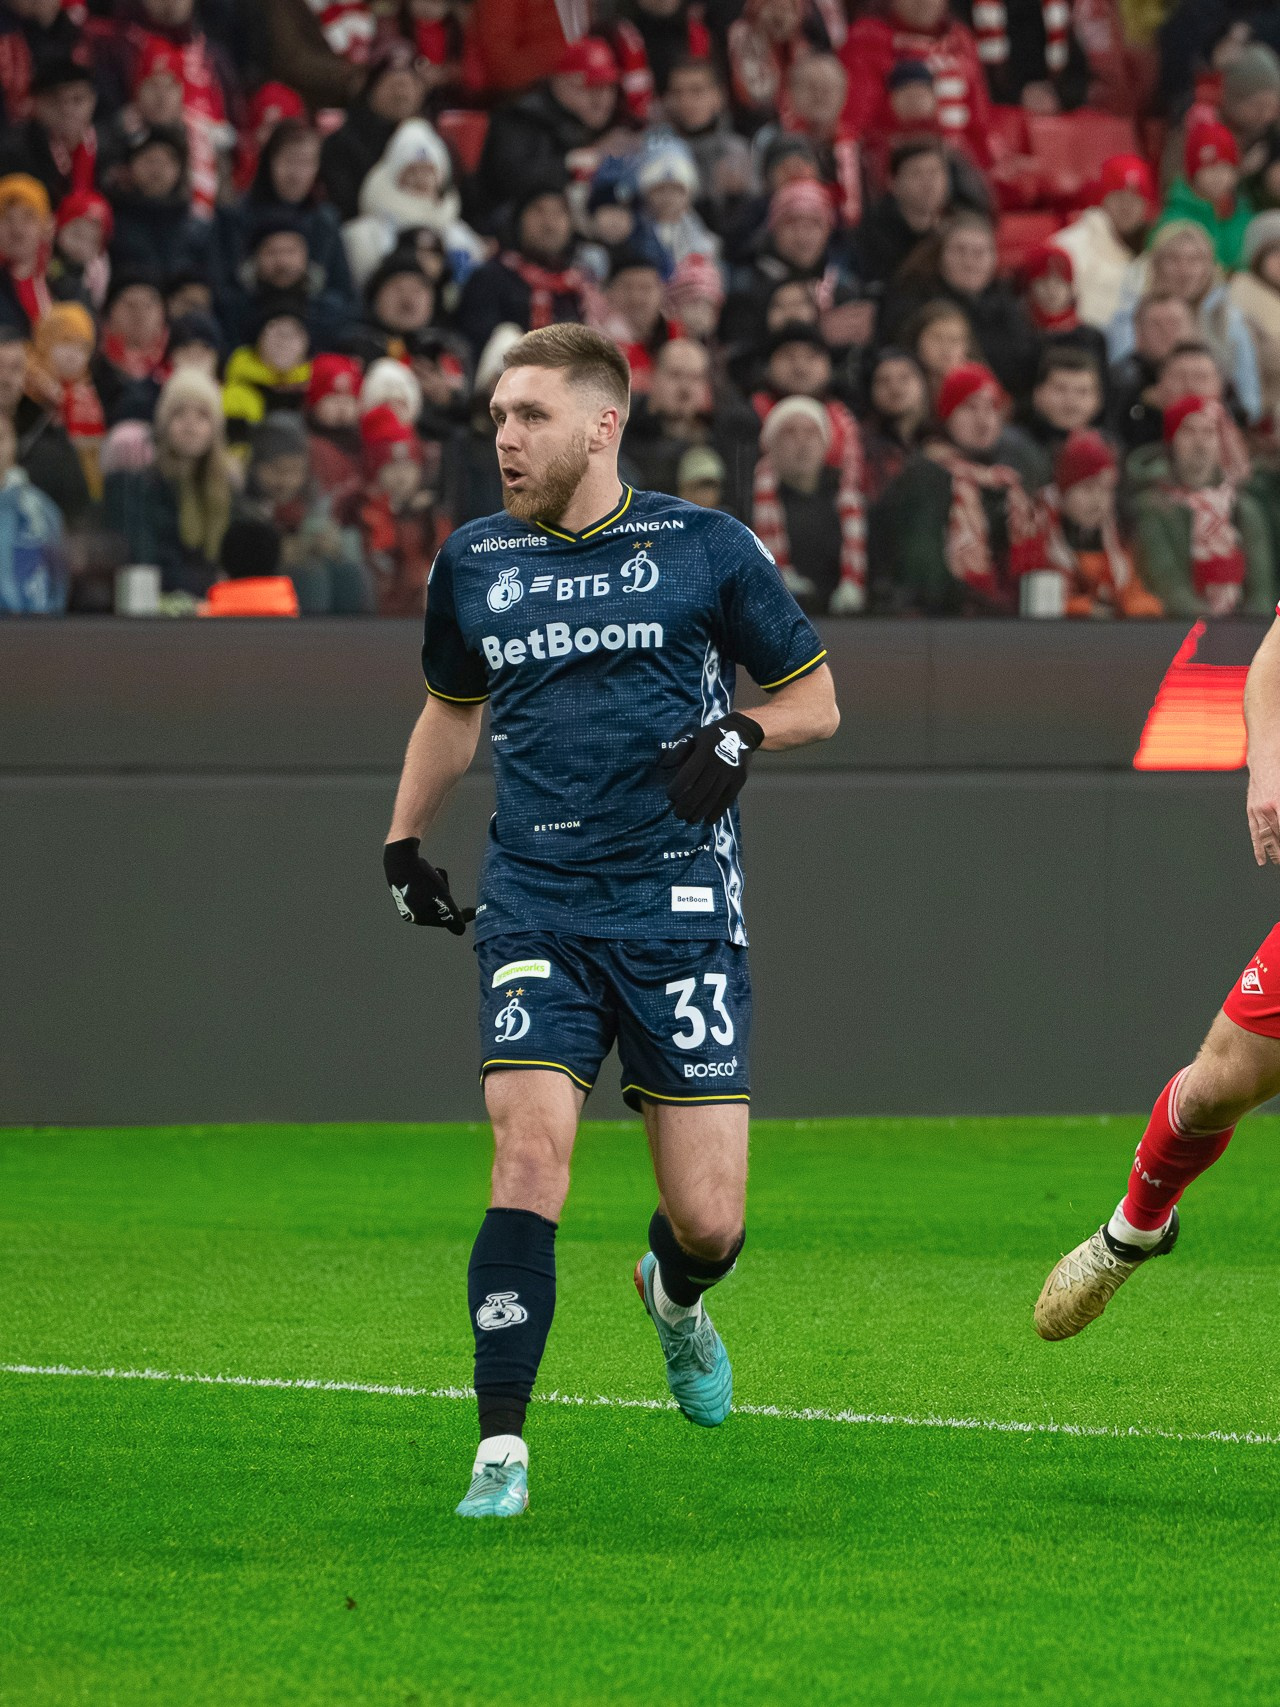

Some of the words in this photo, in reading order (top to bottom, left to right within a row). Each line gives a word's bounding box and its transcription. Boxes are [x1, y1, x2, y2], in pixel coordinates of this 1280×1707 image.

[471, 533, 548, 554] wildberries
[556, 573, 611, 601] ВТБ
[481, 622, 664, 670] BetBoom
[534, 820, 581, 832] BETBOOM
[663, 844, 710, 859] BETBOOM
[677, 895, 708, 903] BetBoom
[665, 973, 734, 1049] 33
[684, 1062, 735, 1078] BOSCO
